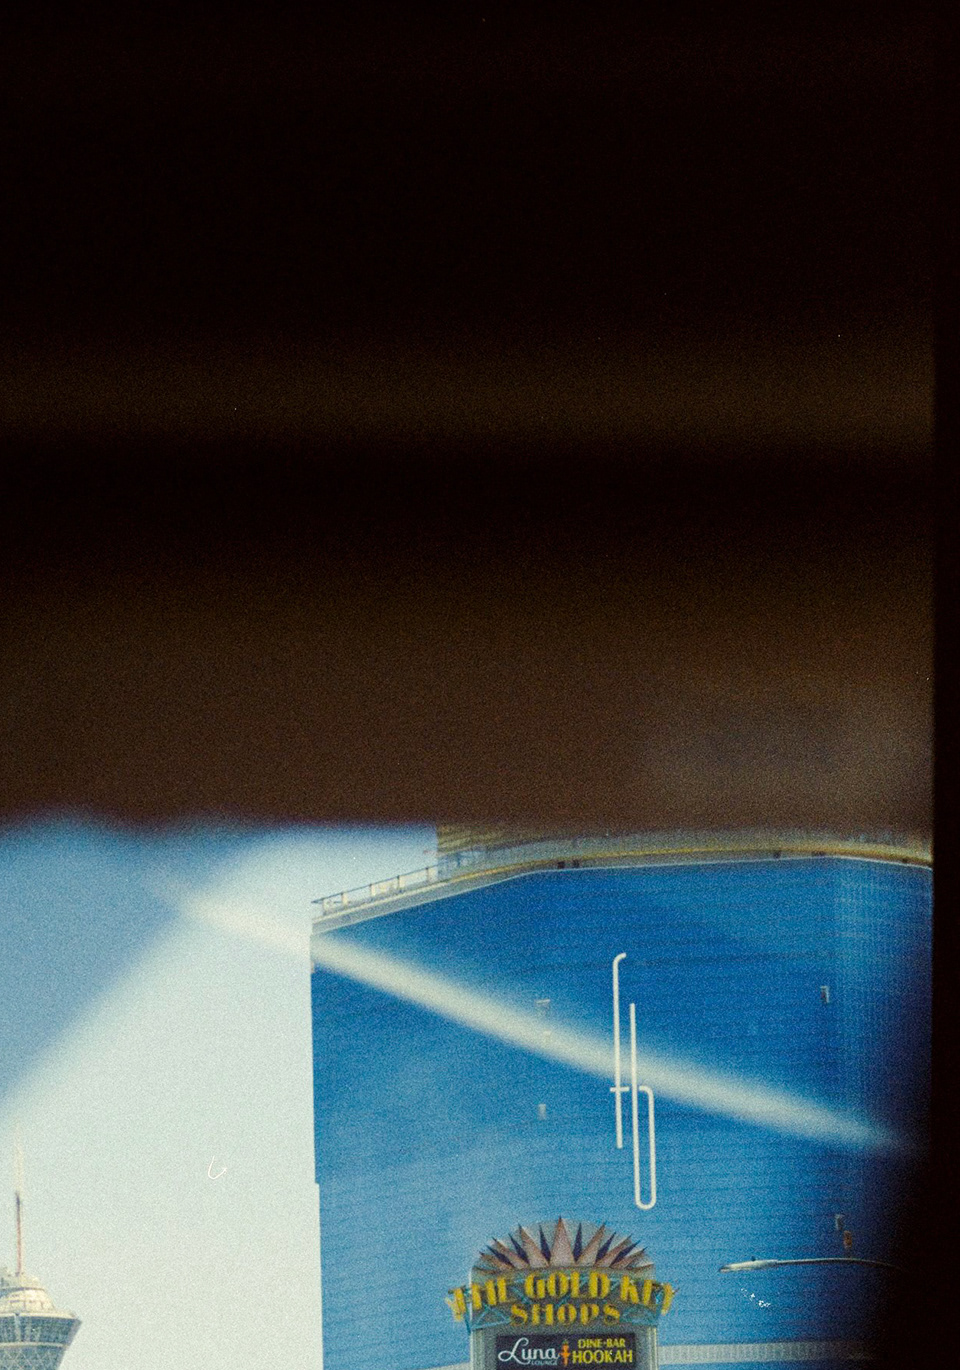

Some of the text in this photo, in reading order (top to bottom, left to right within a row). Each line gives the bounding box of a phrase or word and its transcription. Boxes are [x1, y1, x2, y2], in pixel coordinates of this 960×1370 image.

[447, 1271, 679, 1321] THE GOLD KEY
[511, 1303, 620, 1325] SHOPS
[498, 1337, 559, 1365] Luna
[572, 1349, 633, 1364] HOOKAH
